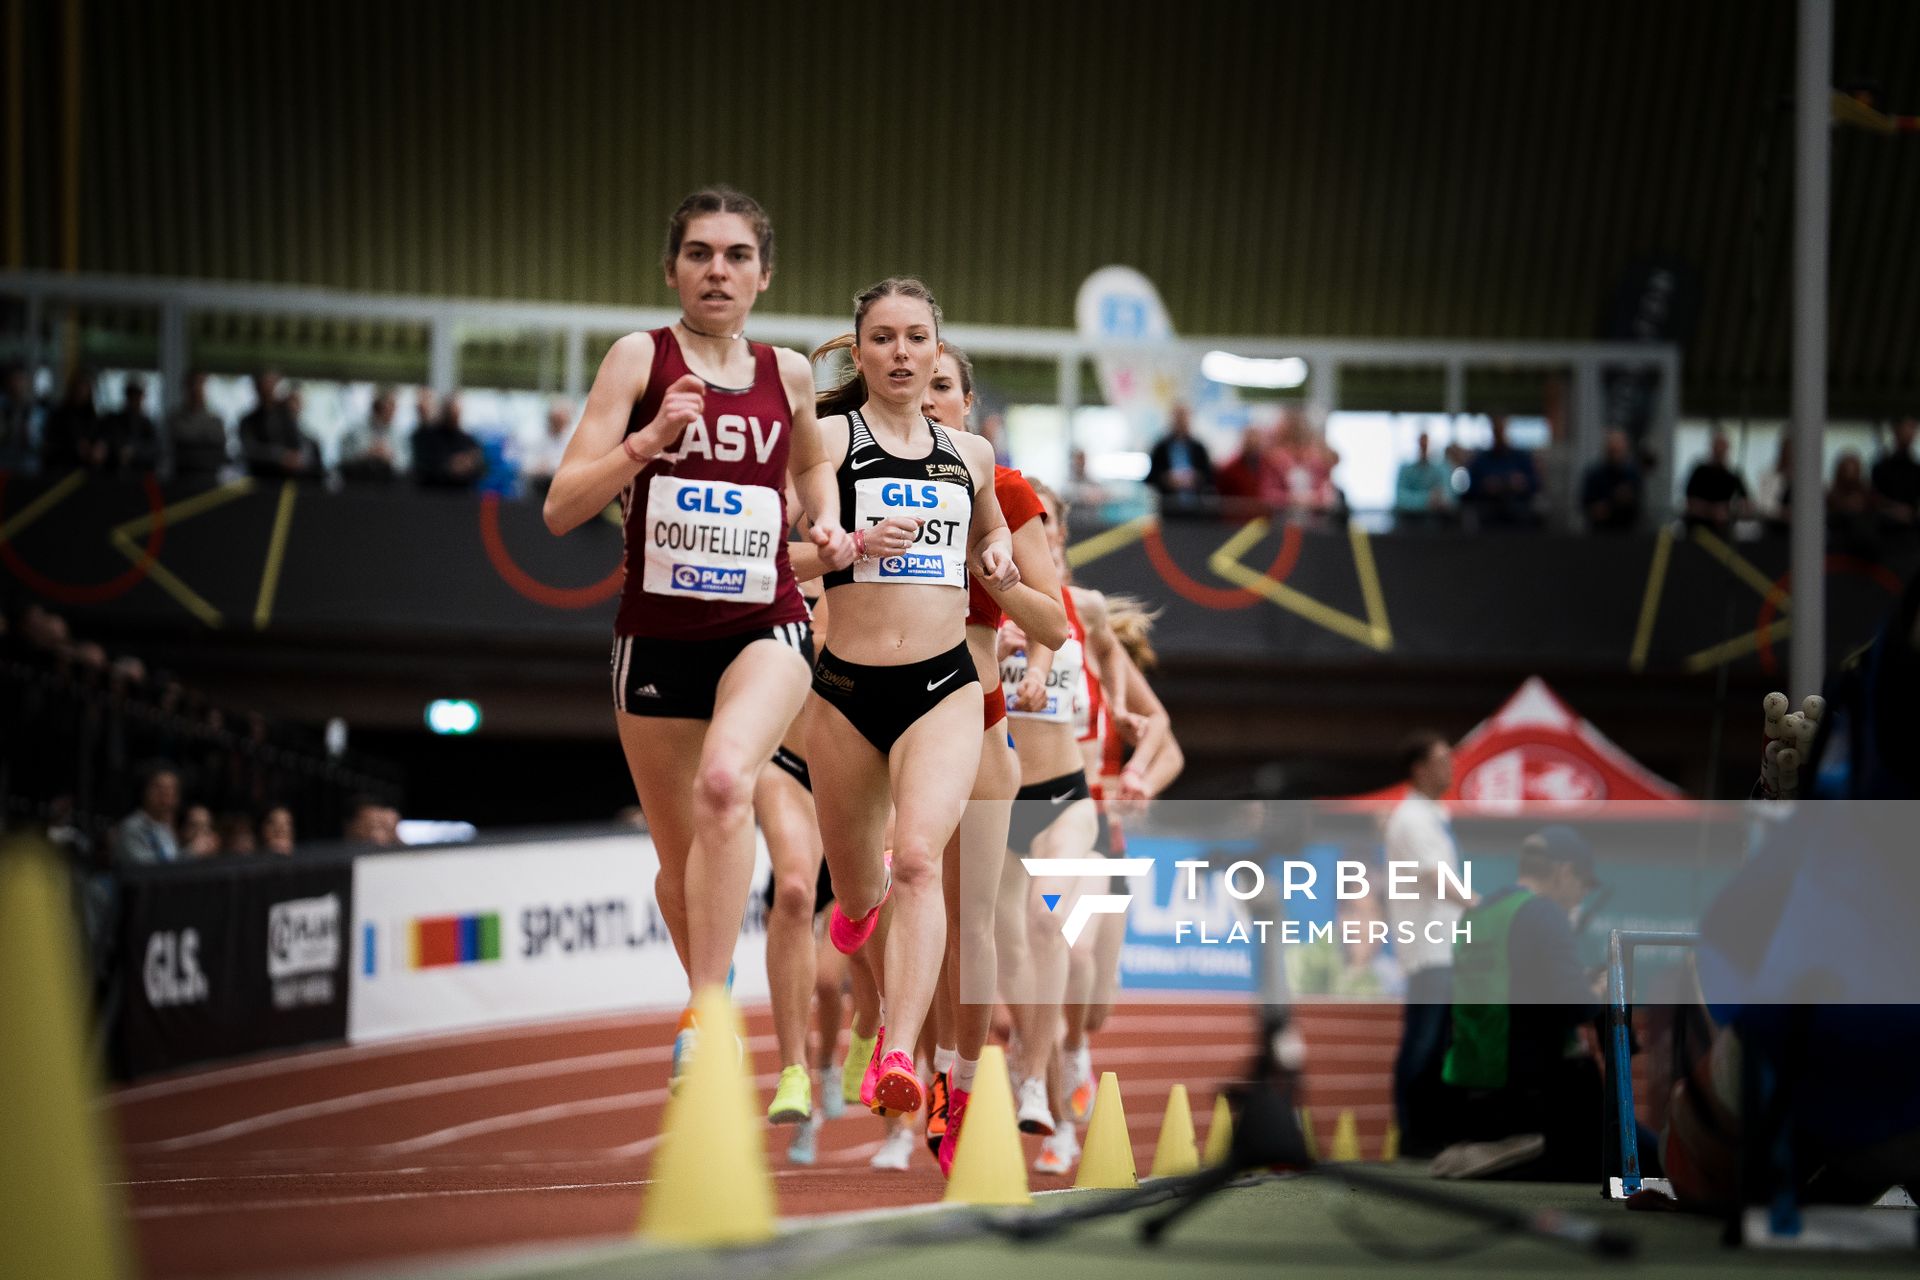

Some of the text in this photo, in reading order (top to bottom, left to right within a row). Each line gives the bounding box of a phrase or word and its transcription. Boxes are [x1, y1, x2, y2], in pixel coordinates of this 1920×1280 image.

[677, 414, 782, 464] ASV
[654, 520, 770, 558] COUTELLIER
[908, 556, 943, 570] PLAN
[702, 570, 744, 585] PLAN
